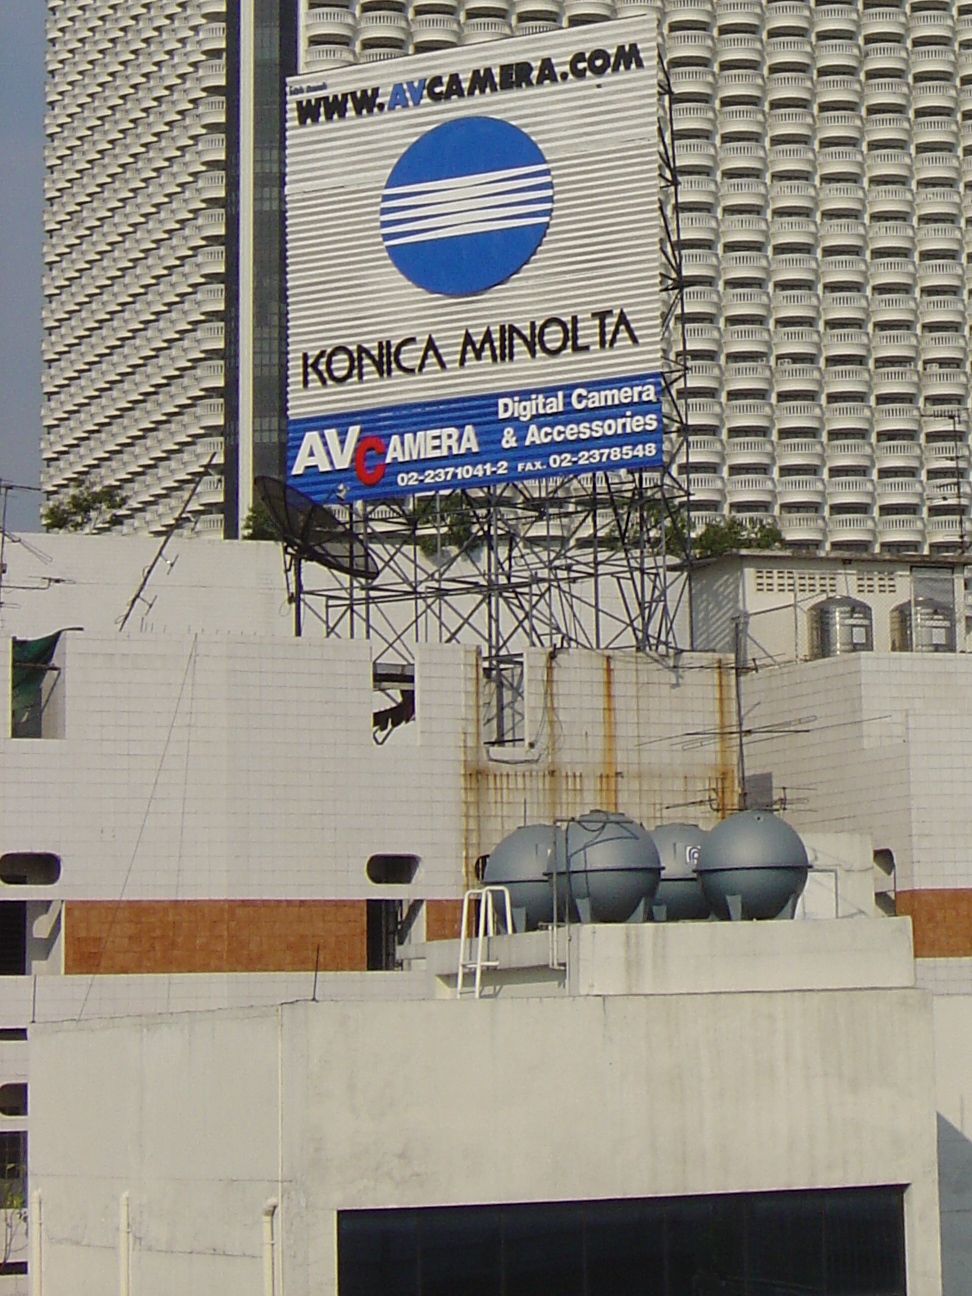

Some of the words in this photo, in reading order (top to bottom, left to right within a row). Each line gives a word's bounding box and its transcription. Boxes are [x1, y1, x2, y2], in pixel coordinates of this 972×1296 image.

[296, 43, 645, 126] WWW.AVCAMERA.COM
[302, 334, 447, 389] KONICA
[459, 308, 639, 368] MINOLTA
[498, 390, 564, 421] Digital
[571, 384, 656, 414] Camera
[501, 428, 518, 449] &
[525, 413, 658, 447] Accessories
[397, 461, 508, 487] 02-2371041-2
[517, 461, 547, 473] FAX.
[549, 443, 657, 469] 02-2378548
